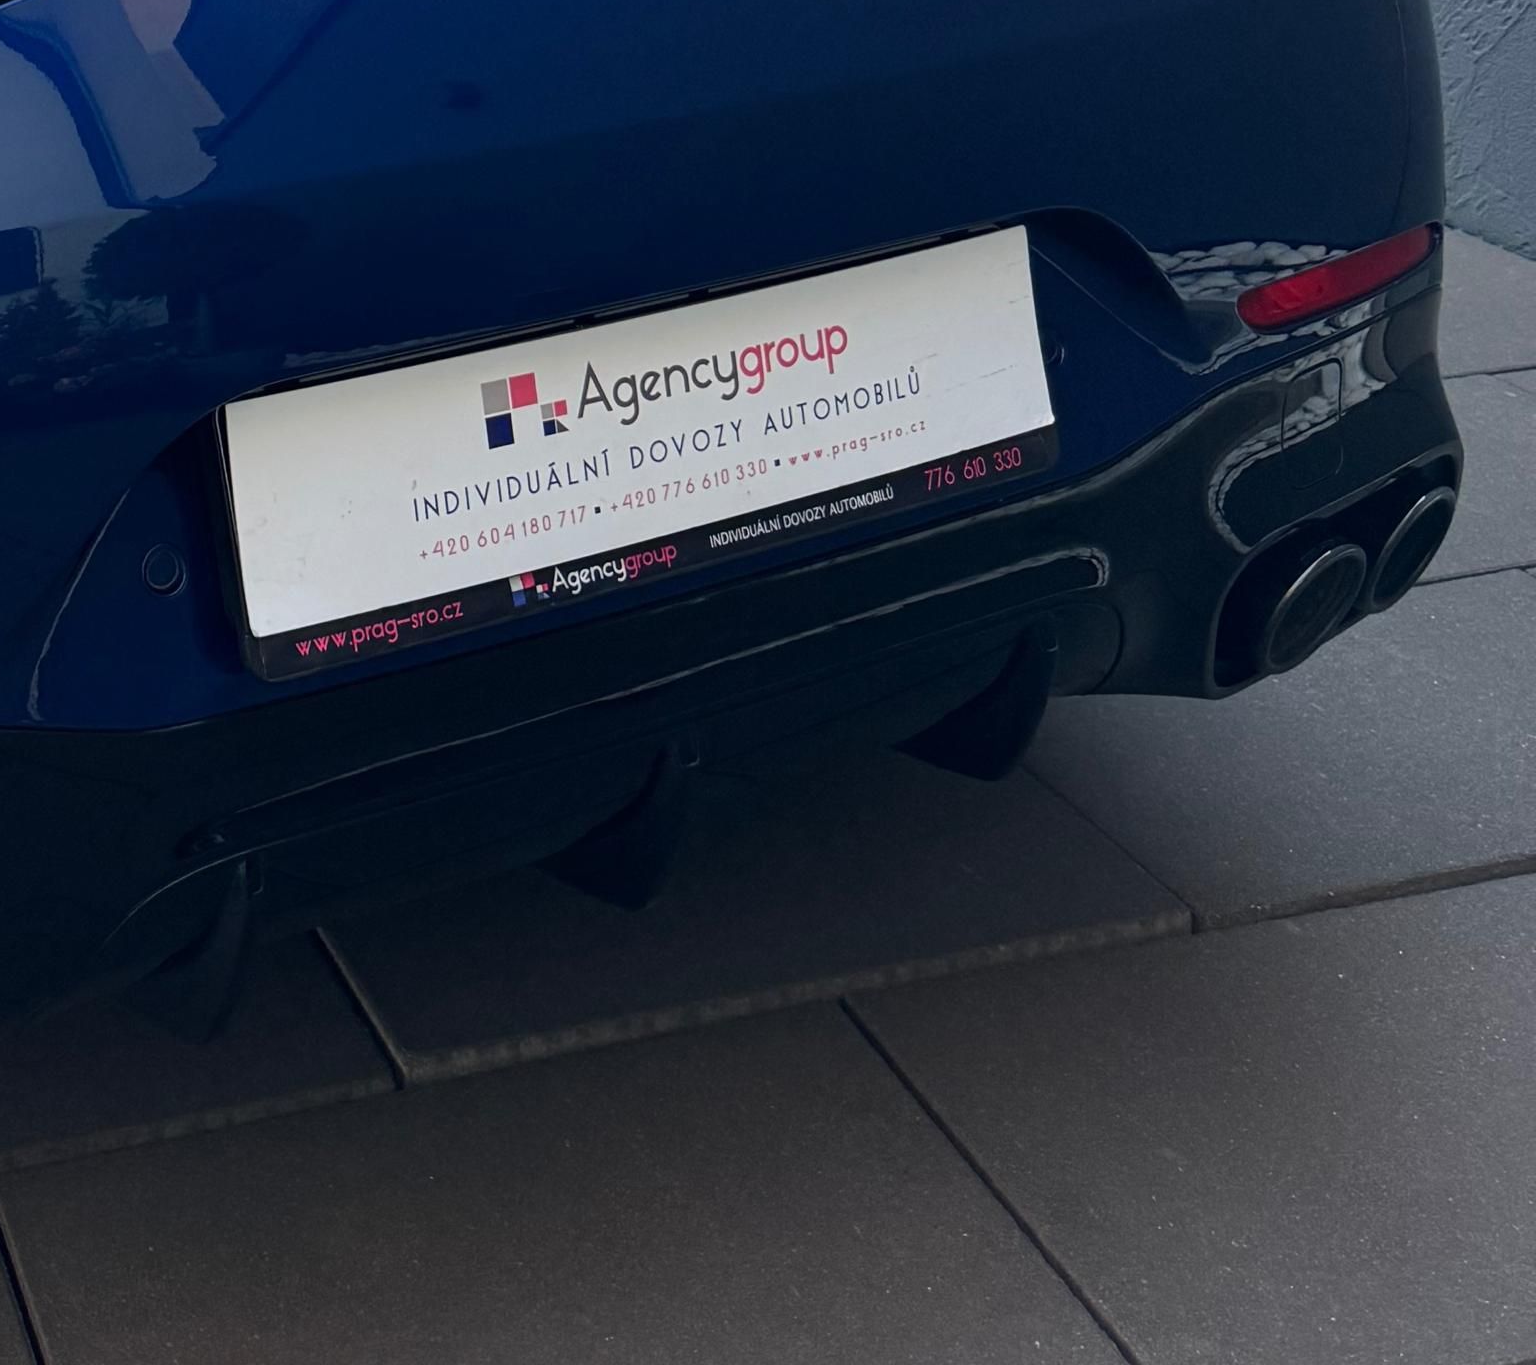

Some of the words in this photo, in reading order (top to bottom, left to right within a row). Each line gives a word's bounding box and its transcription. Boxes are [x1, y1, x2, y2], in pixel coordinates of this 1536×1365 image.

[578, 322, 848, 424] Agencygroup
[413, 448, 610, 521] INDIVIDUÁLNÍ
[630, 419, 743, 469] DOVOZY
[763, 365, 921, 435] AUTOMOBILŮ
[924, 464, 955, 491] 776
[963, 456, 986, 480] 610
[994, 446, 1022, 471] 330
[419, 534, 470, 559] +420
[477, 524, 515, 547] 604
[522, 515, 552, 537] 180
[558, 505, 586, 528] 717
[611, 488, 656, 512] +420
[662, 477, 696, 501] 776
[702, 468, 730, 491] 610
[736, 458, 768, 481] 330
[788, 421, 926, 467] www.prag-sro.cz
[709, 515, 781, 549] INDIVIDUÁLNÍ
[783, 506, 826, 529] DOVOZY
[828, 482, 895, 516] AUTOMOBILŮ
[551, 543, 678, 595] Agencygroup
[296, 600, 463, 657] www.prag-sro.cz
